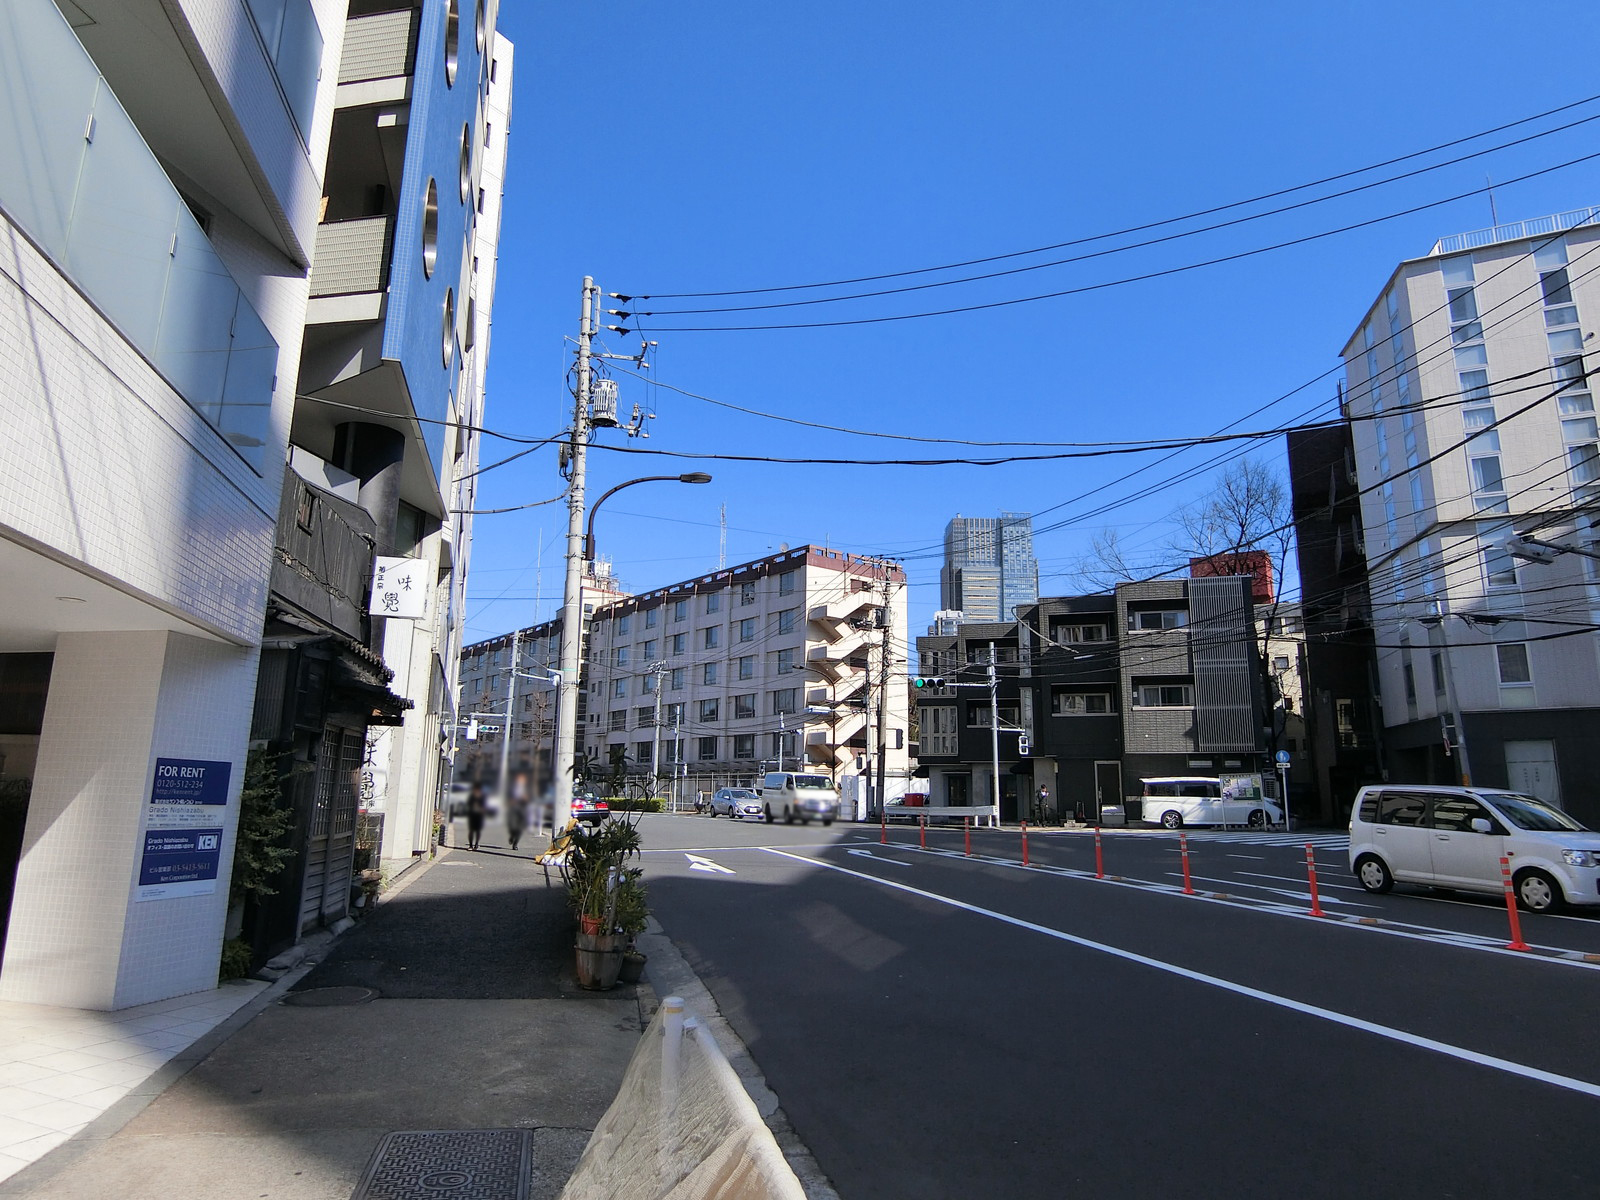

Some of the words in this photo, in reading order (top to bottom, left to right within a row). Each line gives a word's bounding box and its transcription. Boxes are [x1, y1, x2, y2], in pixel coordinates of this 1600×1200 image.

[158, 765, 179, 777] FOR
[180, 767, 206, 778] RENT
[156, 779, 204, 789] 0120-512-234
[198, 835, 218, 850] KEN
